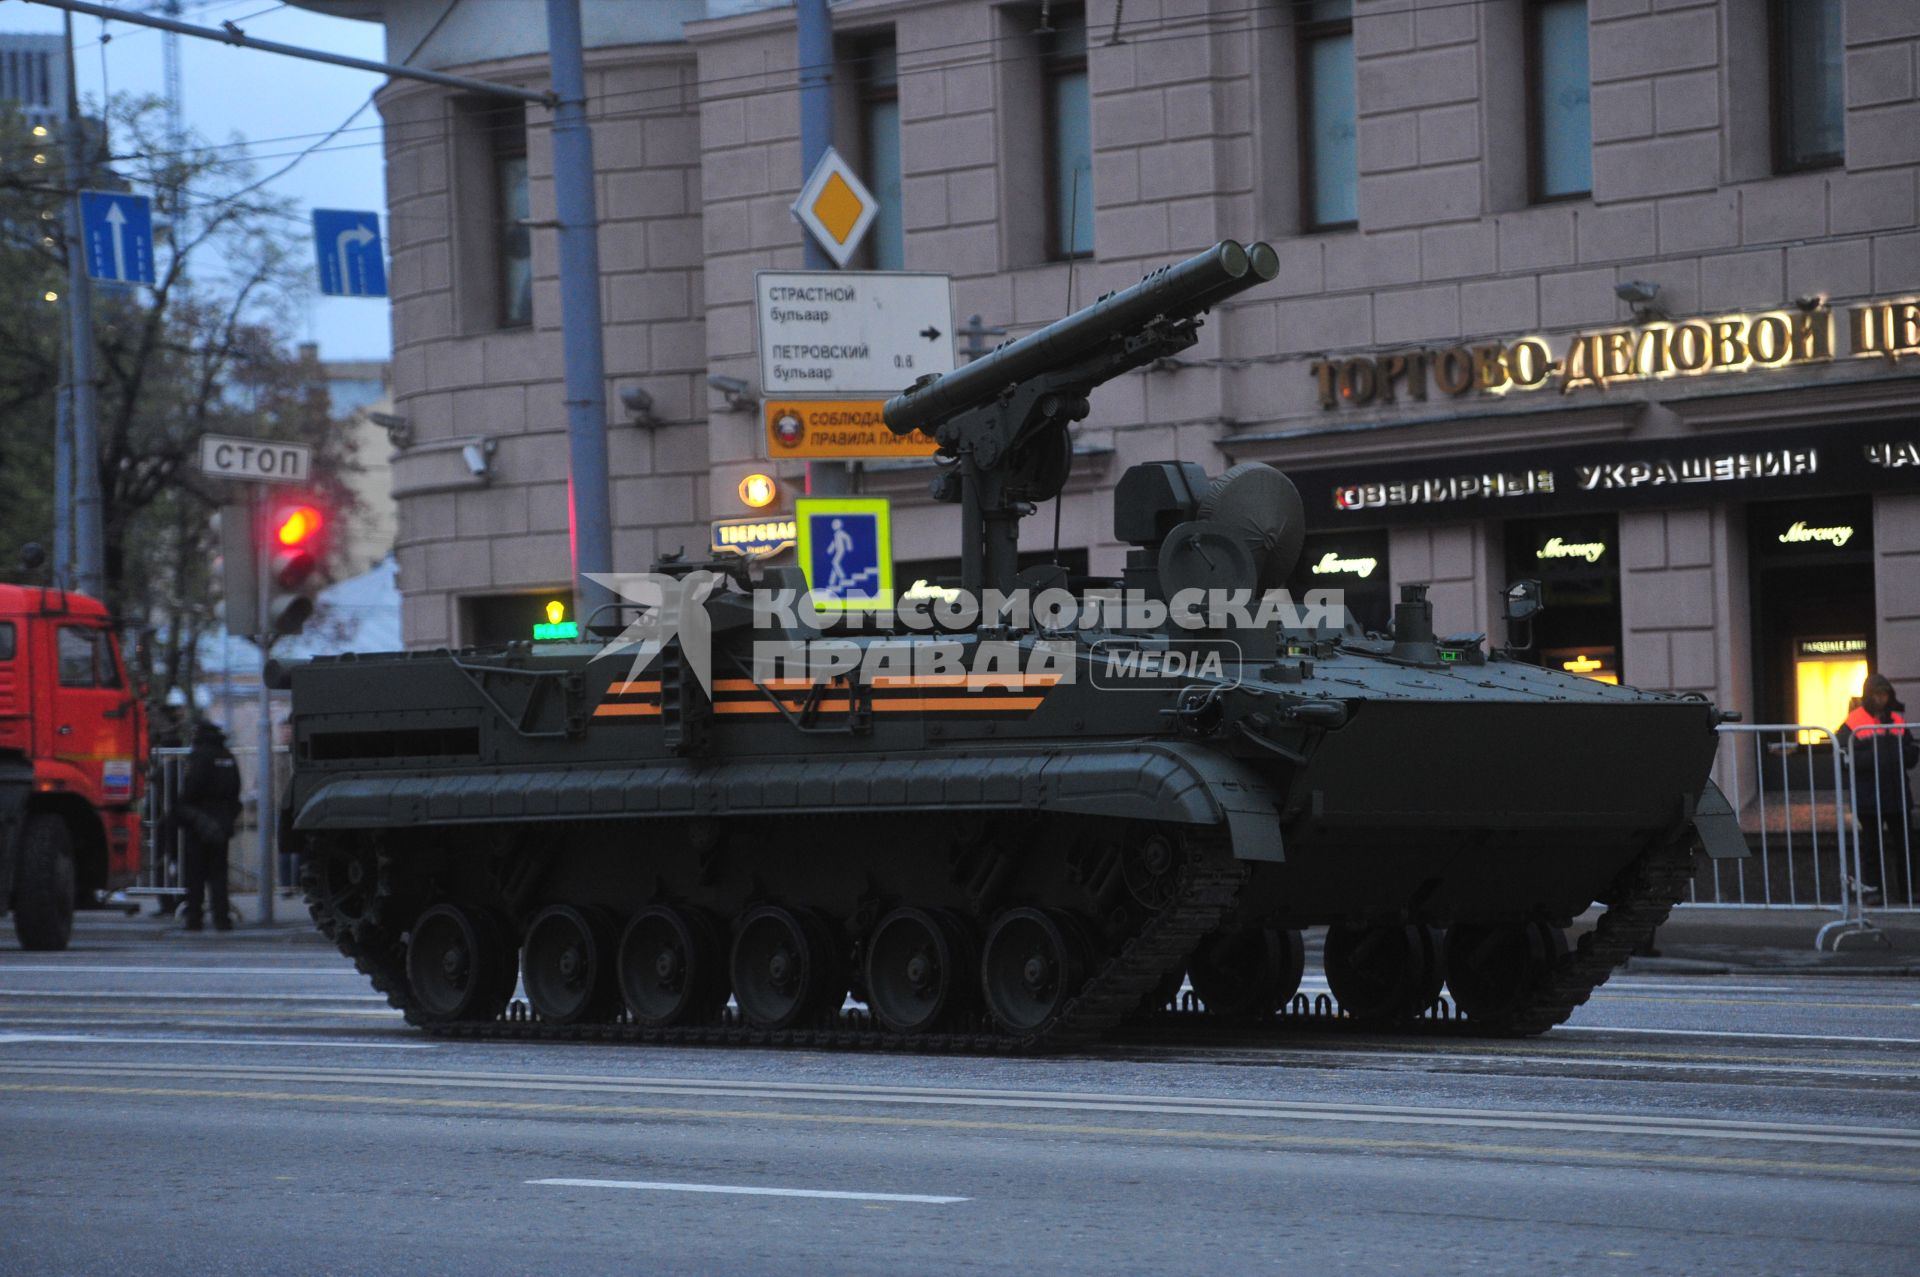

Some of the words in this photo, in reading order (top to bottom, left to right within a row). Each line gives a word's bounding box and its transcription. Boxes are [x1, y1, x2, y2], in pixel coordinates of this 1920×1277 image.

[769, 285, 855, 301] СТРАСТНОЙ
[770, 307, 829, 323] бульвар
[772, 342, 869, 360] ПЕТРОВСКИЙ
[1310, 300, 1834, 411] ТОРГОВО-ДЕЛОВОЙ
[774, 365, 833, 381] бульвар
[809, 411, 885, 427] СОБЛЮДА
[810, 431, 876, 446] ПРАВИЛА
[880, 431, 936, 446] ПАРКОВ
[215, 443, 298, 475] СТОП
[1335, 470, 1555, 510] ЮВЕЛИРНЫЕ
[1576, 448, 1817, 490] УКРАШЕНИЯ
[1779, 521, 1853, 546] Mercury
[1536, 537, 1605, 563] Mercury
